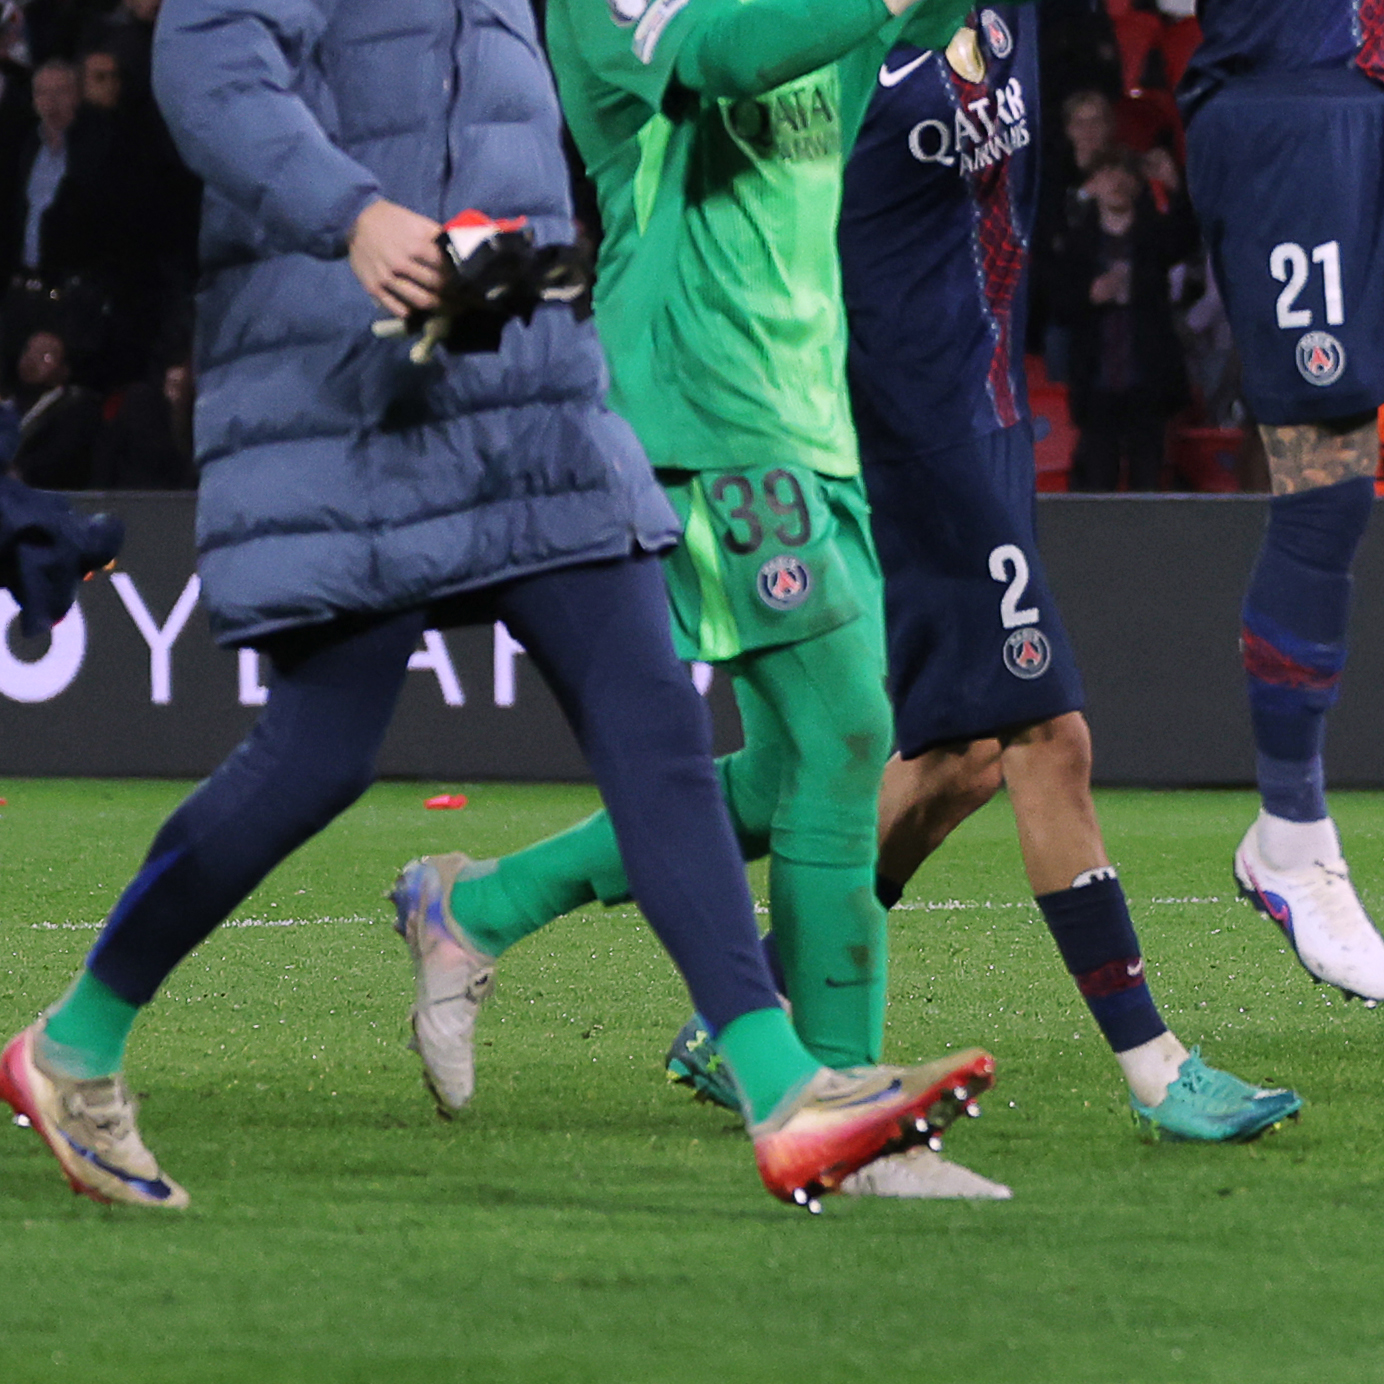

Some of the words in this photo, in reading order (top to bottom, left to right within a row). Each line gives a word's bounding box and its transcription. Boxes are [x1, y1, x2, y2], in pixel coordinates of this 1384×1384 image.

[1269, 240, 1345, 329] 21
[712, 468, 812, 554] 39
[988, 543, 1040, 629] 2
